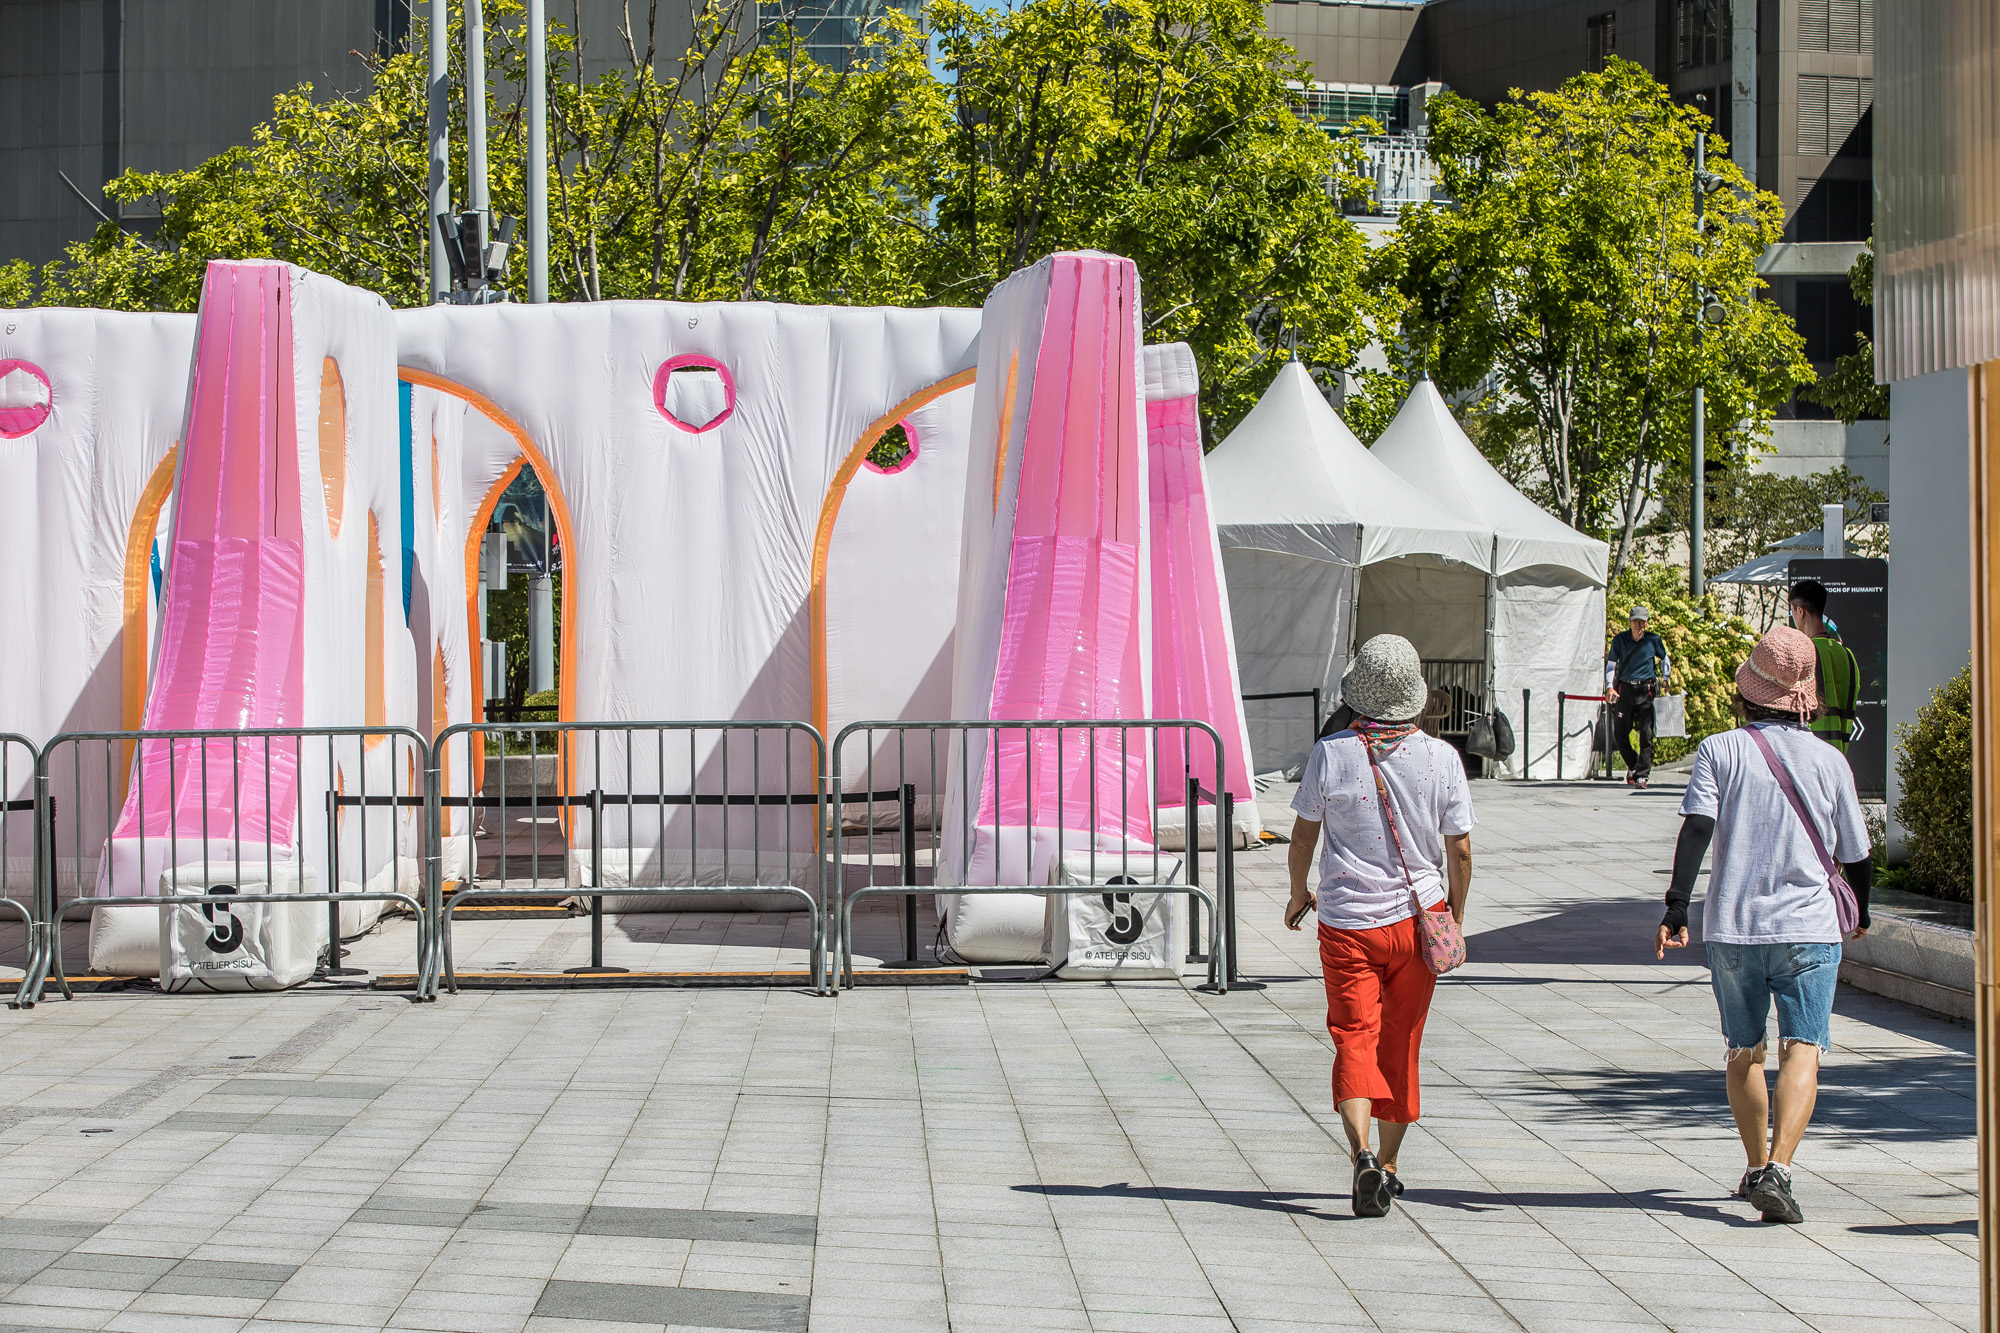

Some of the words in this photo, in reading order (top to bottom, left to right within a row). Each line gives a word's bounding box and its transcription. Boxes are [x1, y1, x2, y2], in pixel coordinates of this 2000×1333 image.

[1094, 951, 1128, 960] ATELIER
[1131, 952, 1151, 960] SISU
[233, 960, 252, 968] SISU
